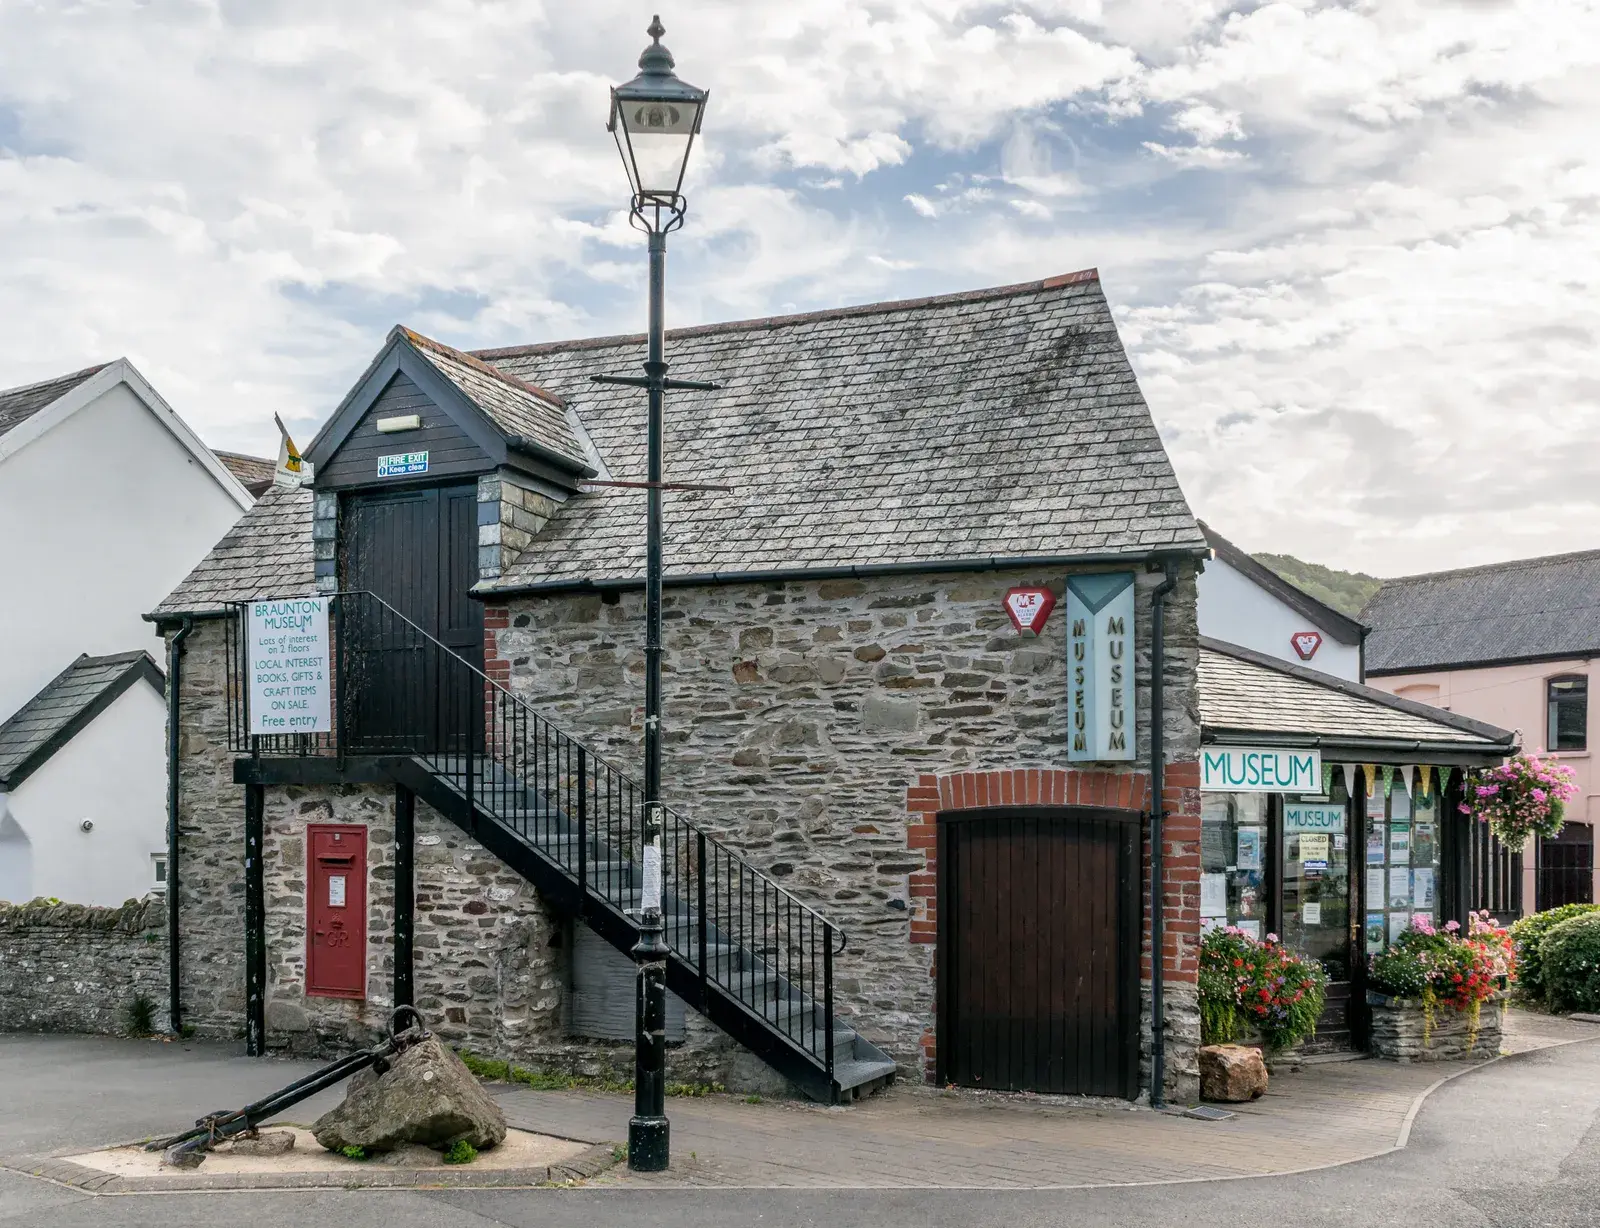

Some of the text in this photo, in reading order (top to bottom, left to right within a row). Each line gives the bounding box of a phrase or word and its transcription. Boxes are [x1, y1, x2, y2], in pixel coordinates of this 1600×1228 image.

[388, 453, 426, 465] FIRE EXIT
[408, 463, 425, 472] clear
[255, 601, 322, 617] BRAUNTON
[265, 615, 312, 629] MUSEUM
[259, 635, 318, 645] Lots of interest
[280, 644, 286, 653] 2
[288, 644, 310, 652] floors
[255, 657, 323, 670] LOCAL INTEREST
[257, 671, 323, 684] BOOKS, GIFTS &
[1107, 616, 1126, 751] MUSEUM
[263, 686, 317, 697] CRAFT ITEMS
[1072, 618, 1087, 752] MUSEUM
[271, 700, 309, 710] ON SALE.
[262, 715, 318, 728] Free entry
[1204, 752, 1314, 787] MUSEUM
[1286, 810, 1342, 827] MUSEUM
[327, 931, 351, 948] GR
